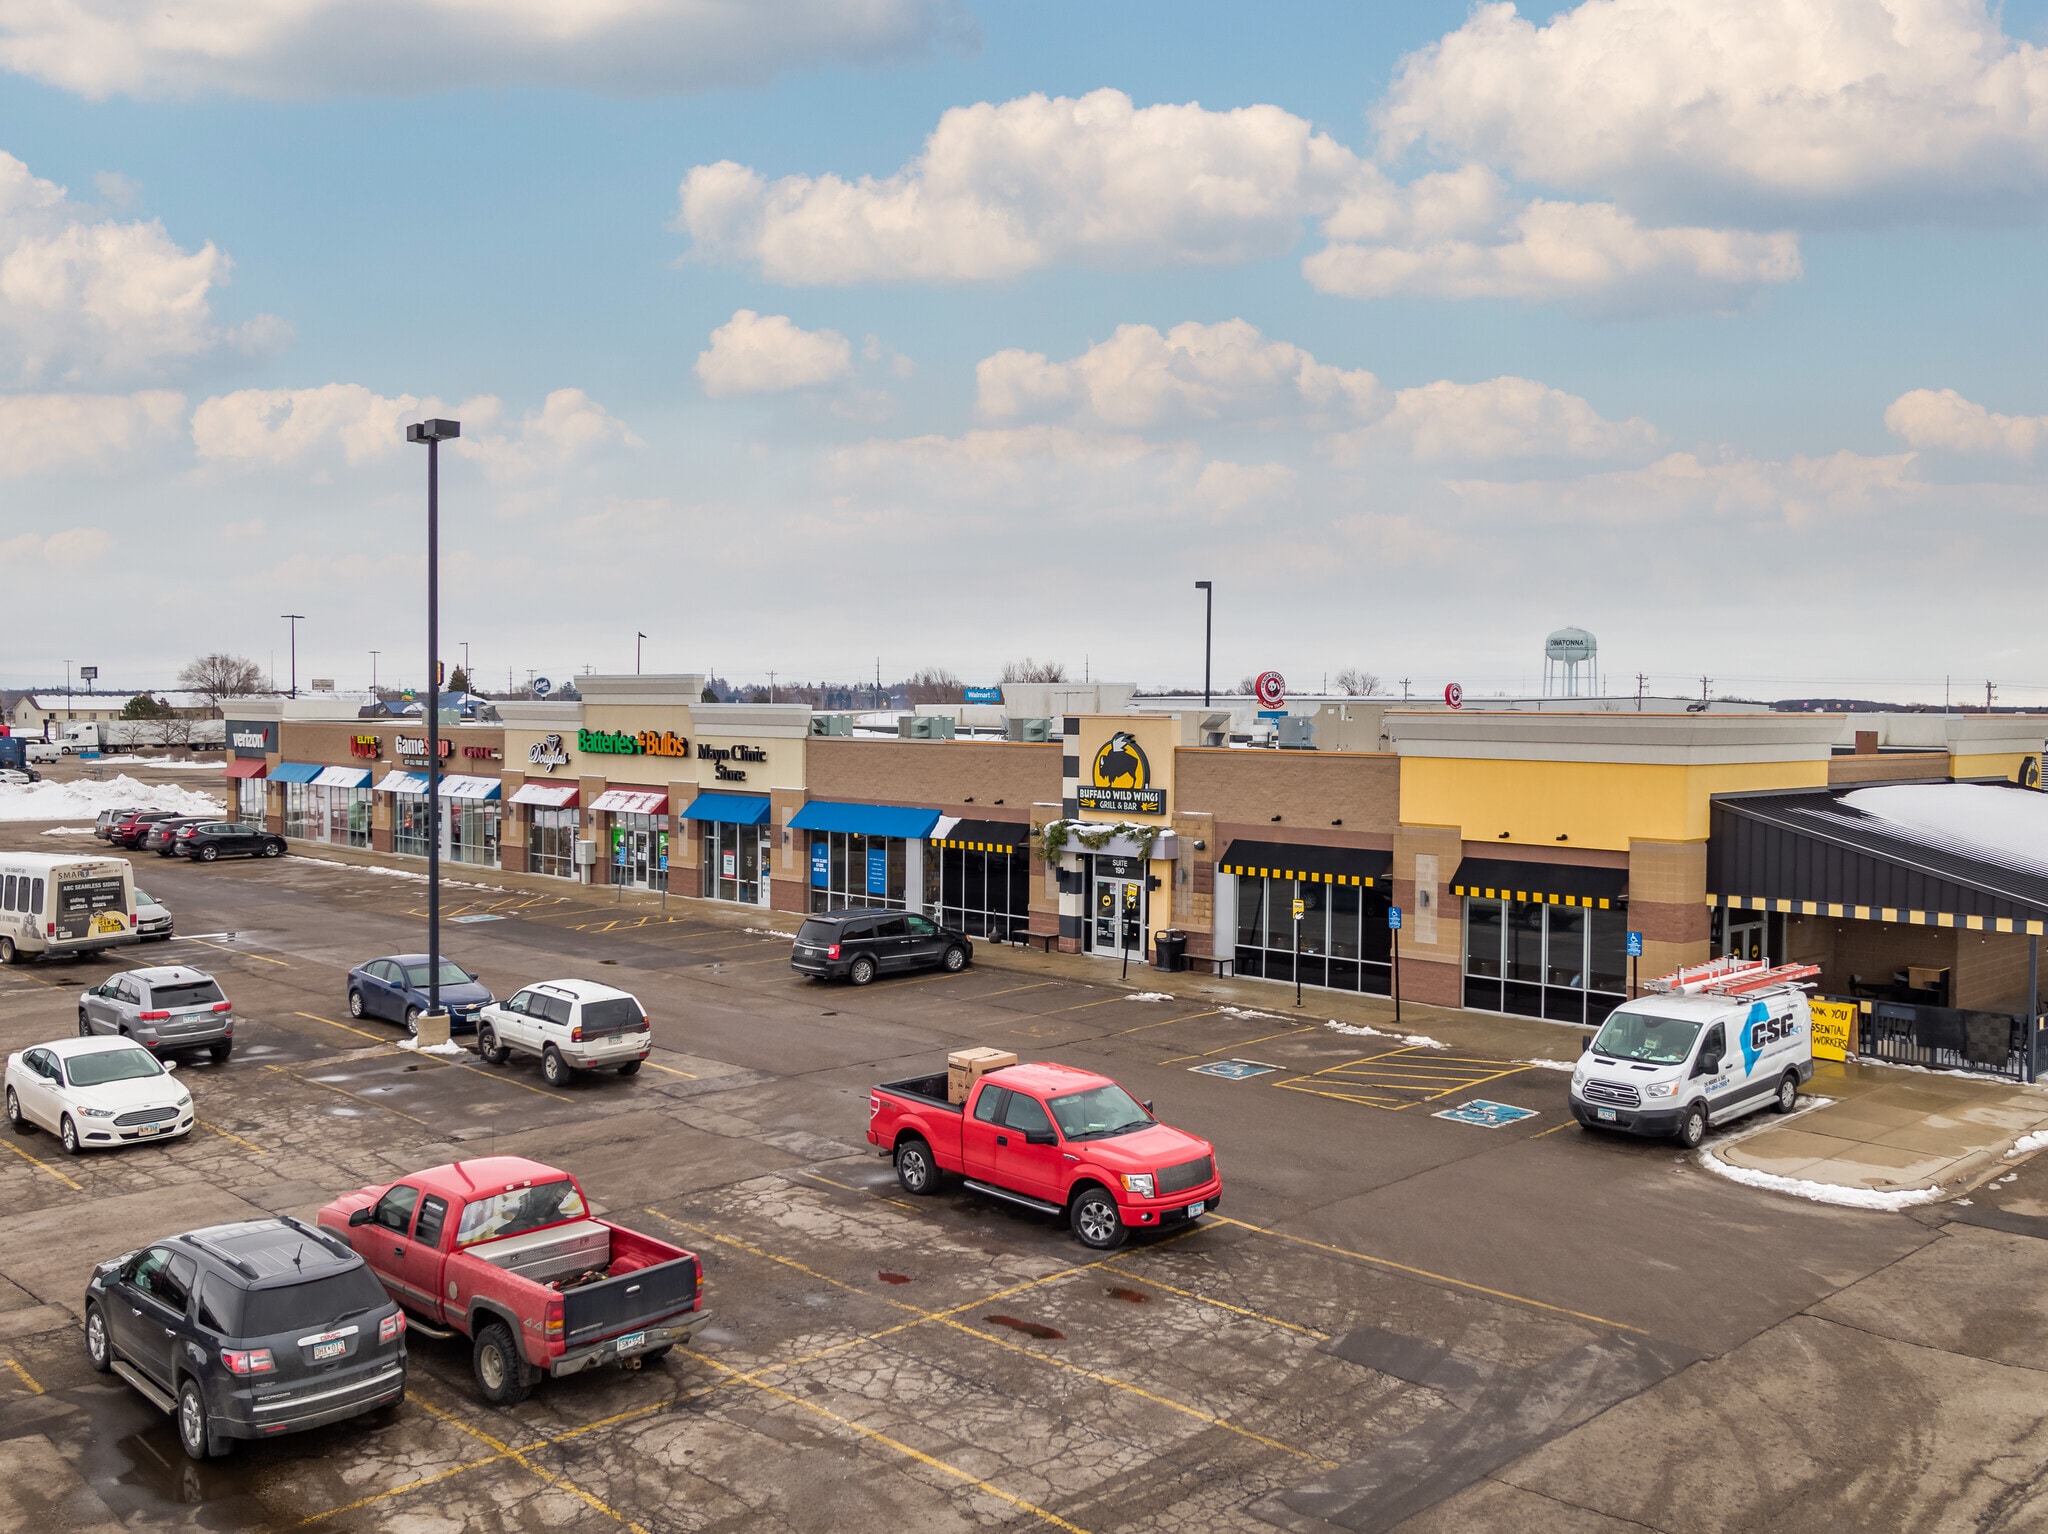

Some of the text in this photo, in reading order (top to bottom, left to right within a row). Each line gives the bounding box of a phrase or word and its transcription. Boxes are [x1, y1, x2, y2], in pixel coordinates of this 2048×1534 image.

[1550, 639, 1584, 647] OWATONNA
[233, 729, 265, 748] verizon
[357, 735, 375, 744] ELITE
[577, 729, 687, 757] Batteries Bulbs
[461, 746, 497, 760] GNC
[528, 743, 570, 773] Douglas
[697, 743, 768, 765] Mayo Clinic
[715, 764, 746, 781] Store
[1080, 788, 1159, 802] BUFFALO WILD WINGS
[1099, 800, 1116, 809] GRILL
[1123, 802, 1138, 810] BAR
[1112, 859, 1128, 867] SUITE
[58, 870, 90, 880] SMART
[1115, 867, 1125, 875] 190
[75, 882, 102, 890] SEAMLESS
[98, 917, 121, 927] abc
[1811, 1006, 1827, 1017] ANK
[1831, 1009, 1848, 1021] YOU
[1751, 1012, 1794, 1050] CSG
[1811, 1021, 1847, 1037] SSENTIAL
[1813, 1035, 1849, 1052] WORKERS
[321, 1331, 342, 1341] GMC
